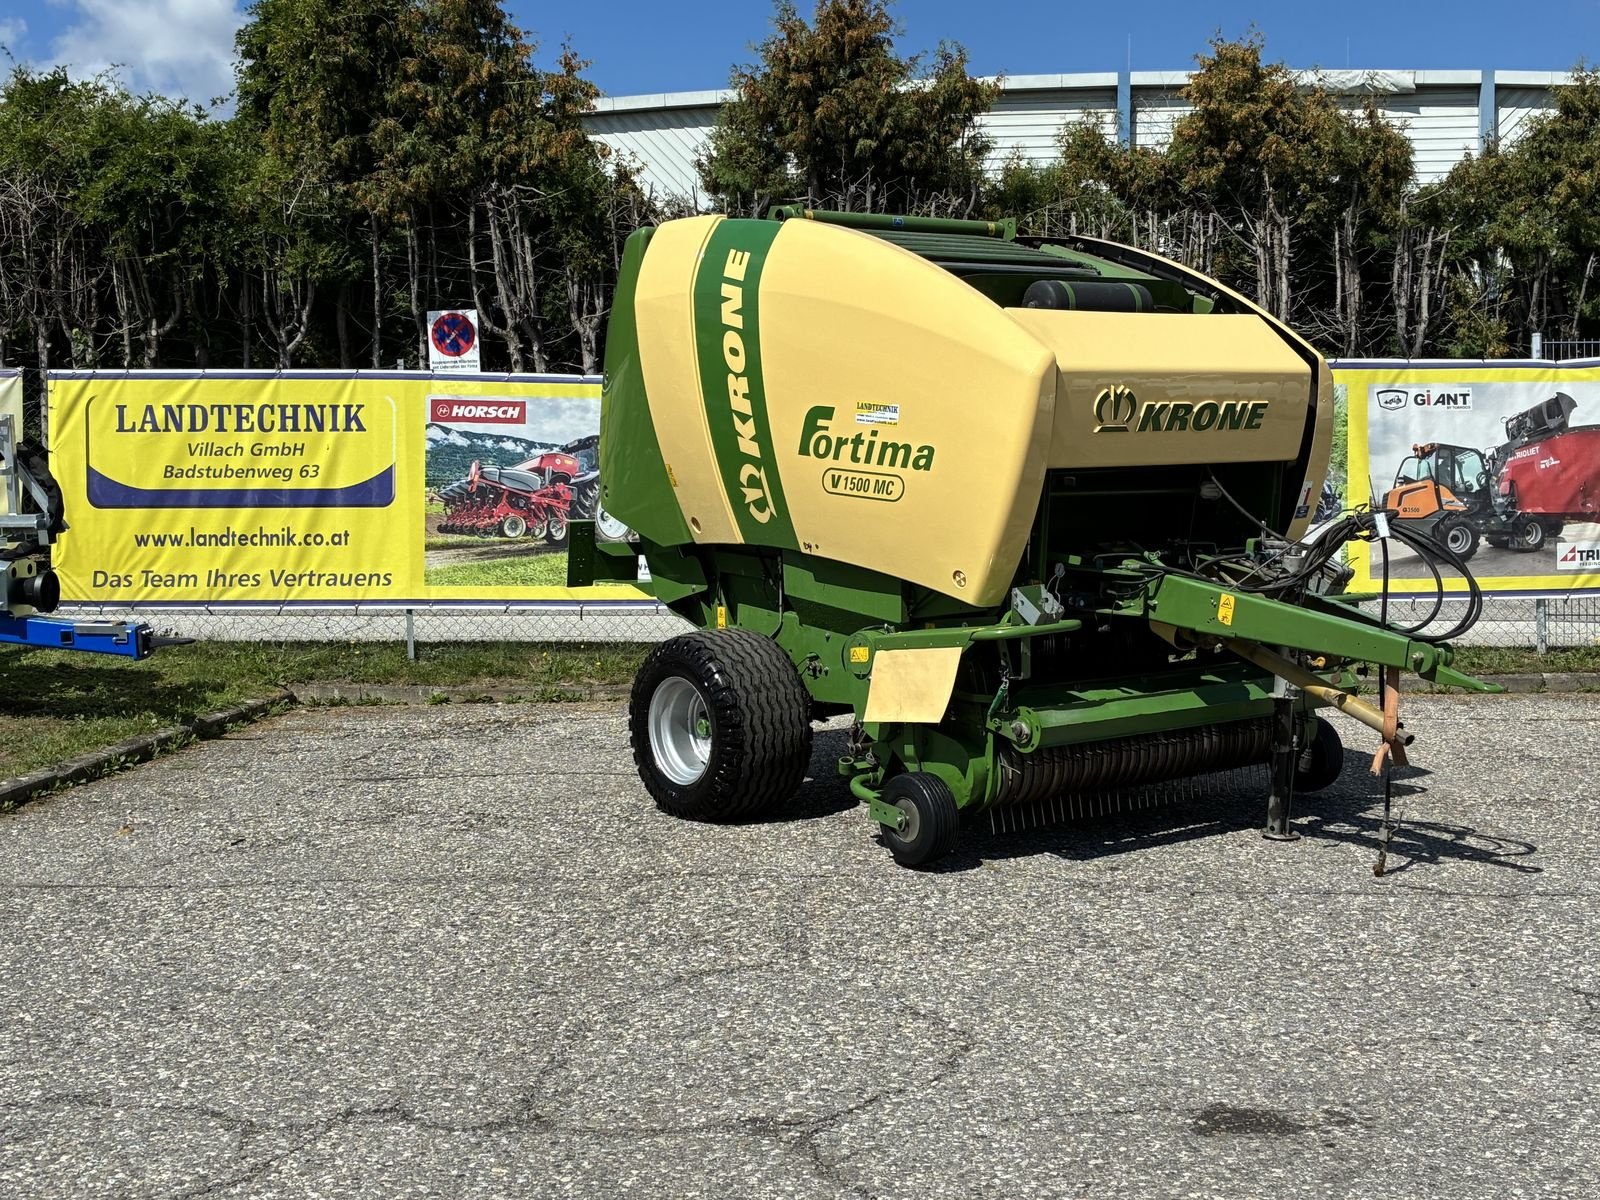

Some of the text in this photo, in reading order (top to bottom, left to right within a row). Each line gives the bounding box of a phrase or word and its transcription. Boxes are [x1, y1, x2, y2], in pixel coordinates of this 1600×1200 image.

[720, 248, 762, 459] KRONE
[451, 405, 521, 419] HORSCH
[857, 402, 898, 413] LANDTECHNIK
[1136, 400, 1270, 433] KRONE
[115, 404, 367, 433] LANDTECHNIK
[798, 405, 936, 472] Fortima
[187, 442, 305, 457] Villach GmbH
[163, 464, 320, 482] Badstubenweg 63
[831, 474, 895, 496] V 1500 MC
[134, 526, 350, 547] www.landtechnik.co.at
[92, 569, 393, 588] Das Team Ihres Vertrauens
